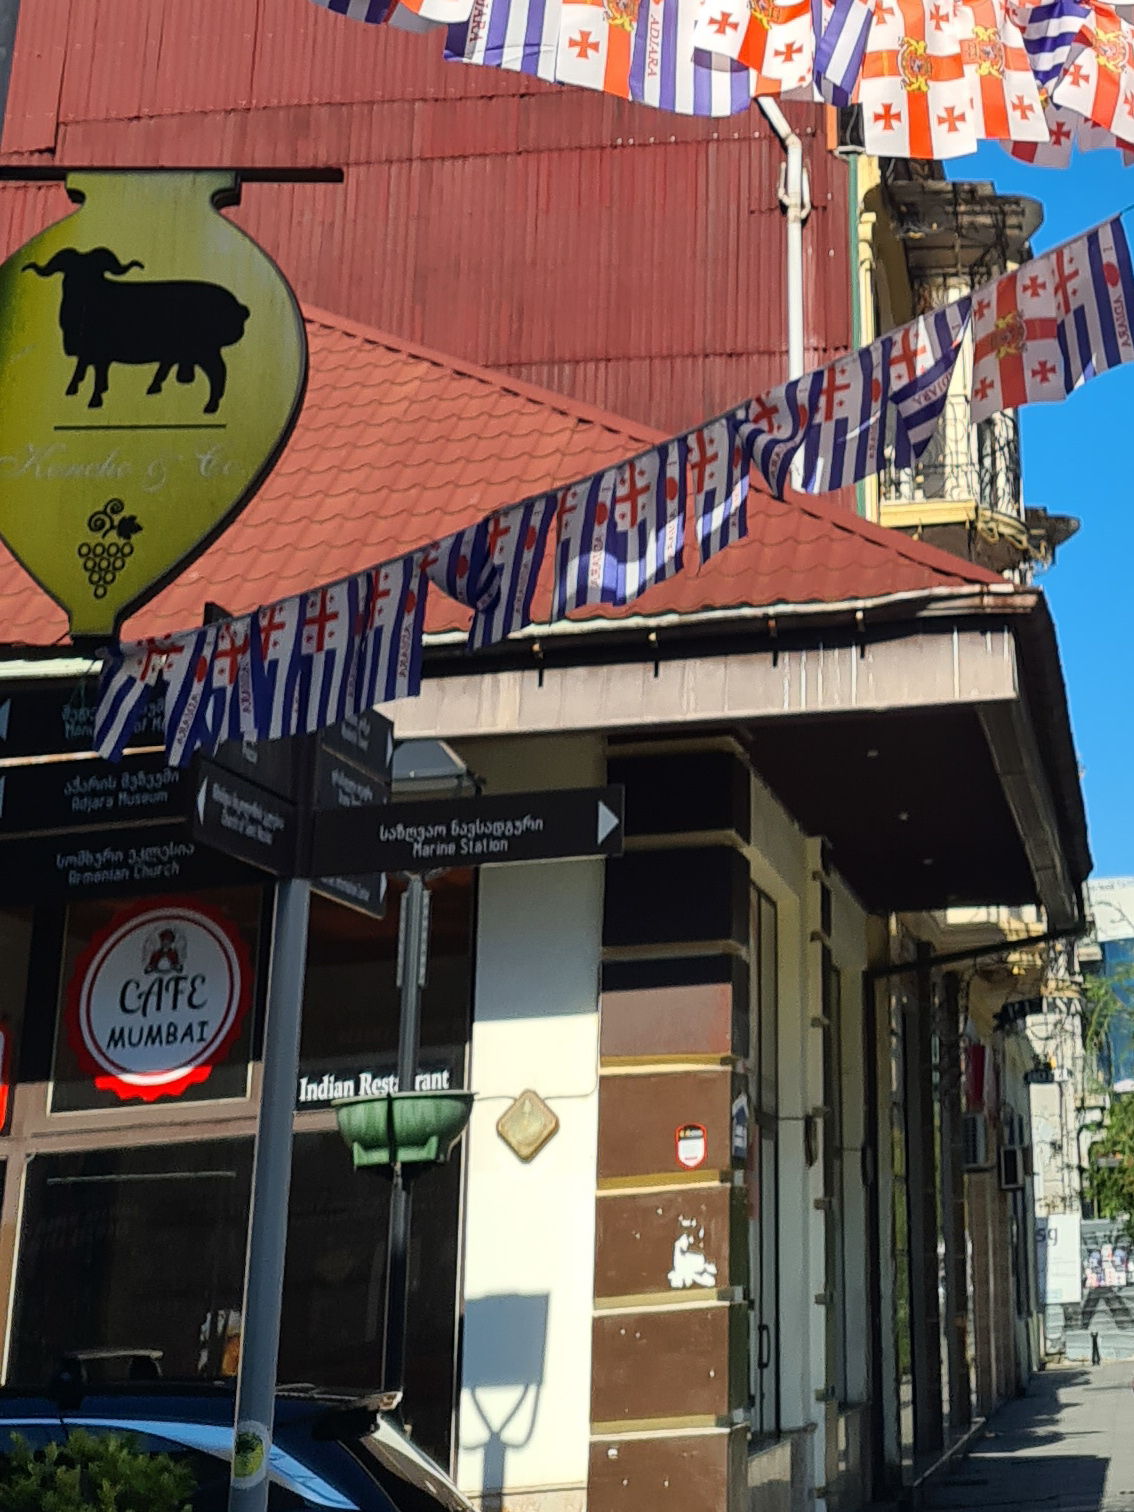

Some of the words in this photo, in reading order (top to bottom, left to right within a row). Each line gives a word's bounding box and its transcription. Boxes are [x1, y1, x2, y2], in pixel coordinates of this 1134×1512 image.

[647, 13, 661, 78] ADJARA
[72, 795, 114, 813] Adjara
[118, 790, 168, 808] Museum
[380, 823, 447, 843] საზღვაო
[451, 814, 544, 839] ნავსადგური
[413, 839, 456, 859] Marine
[460, 837, 508, 855] Station
[68, 867, 130, 886] Armenian
[133, 860, 180, 880] Church
[119, 974, 209, 1018] CAFE
[106, 1020, 210, 1050] MUMBAI
[299, 1073, 355, 1102] Indian
[358, 1068, 450, 1096] Restarant
